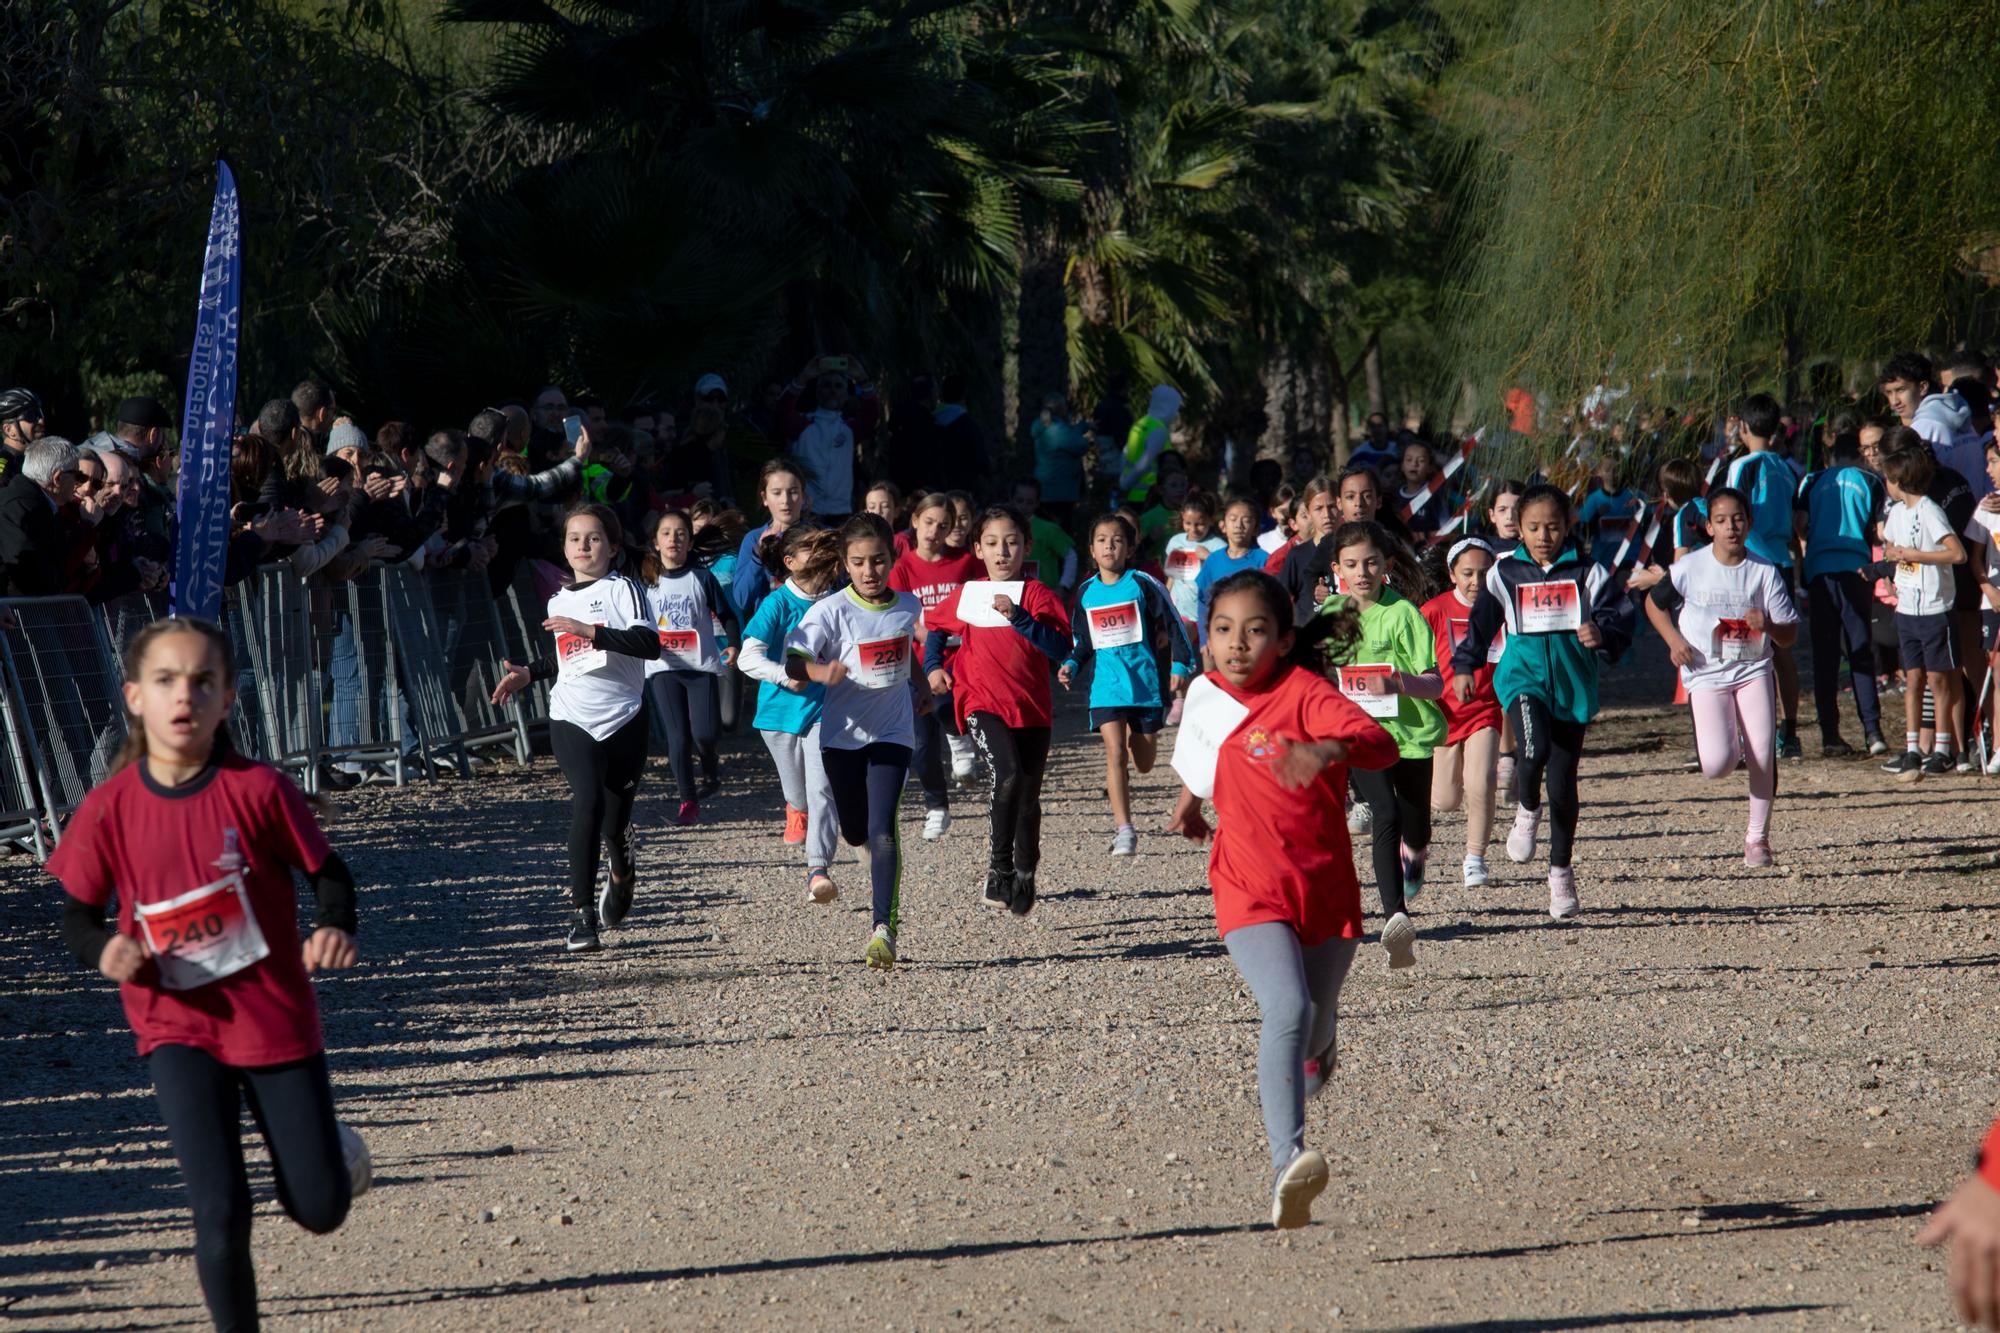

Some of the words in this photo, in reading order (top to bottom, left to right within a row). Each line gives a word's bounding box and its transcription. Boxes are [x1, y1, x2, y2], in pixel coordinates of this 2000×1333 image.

[937, 582, 959, 594] MAT
[657, 595, 694, 614] Vicente
[1531, 592, 1563, 608] 141
[668, 610, 690, 627] Ros
[1100, 613, 1126, 628] 301
[566, 638, 592, 656] 295
[663, 638, 687, 649] 297
[874, 647, 904, 666] 220
[162, 913, 225, 955] 240
